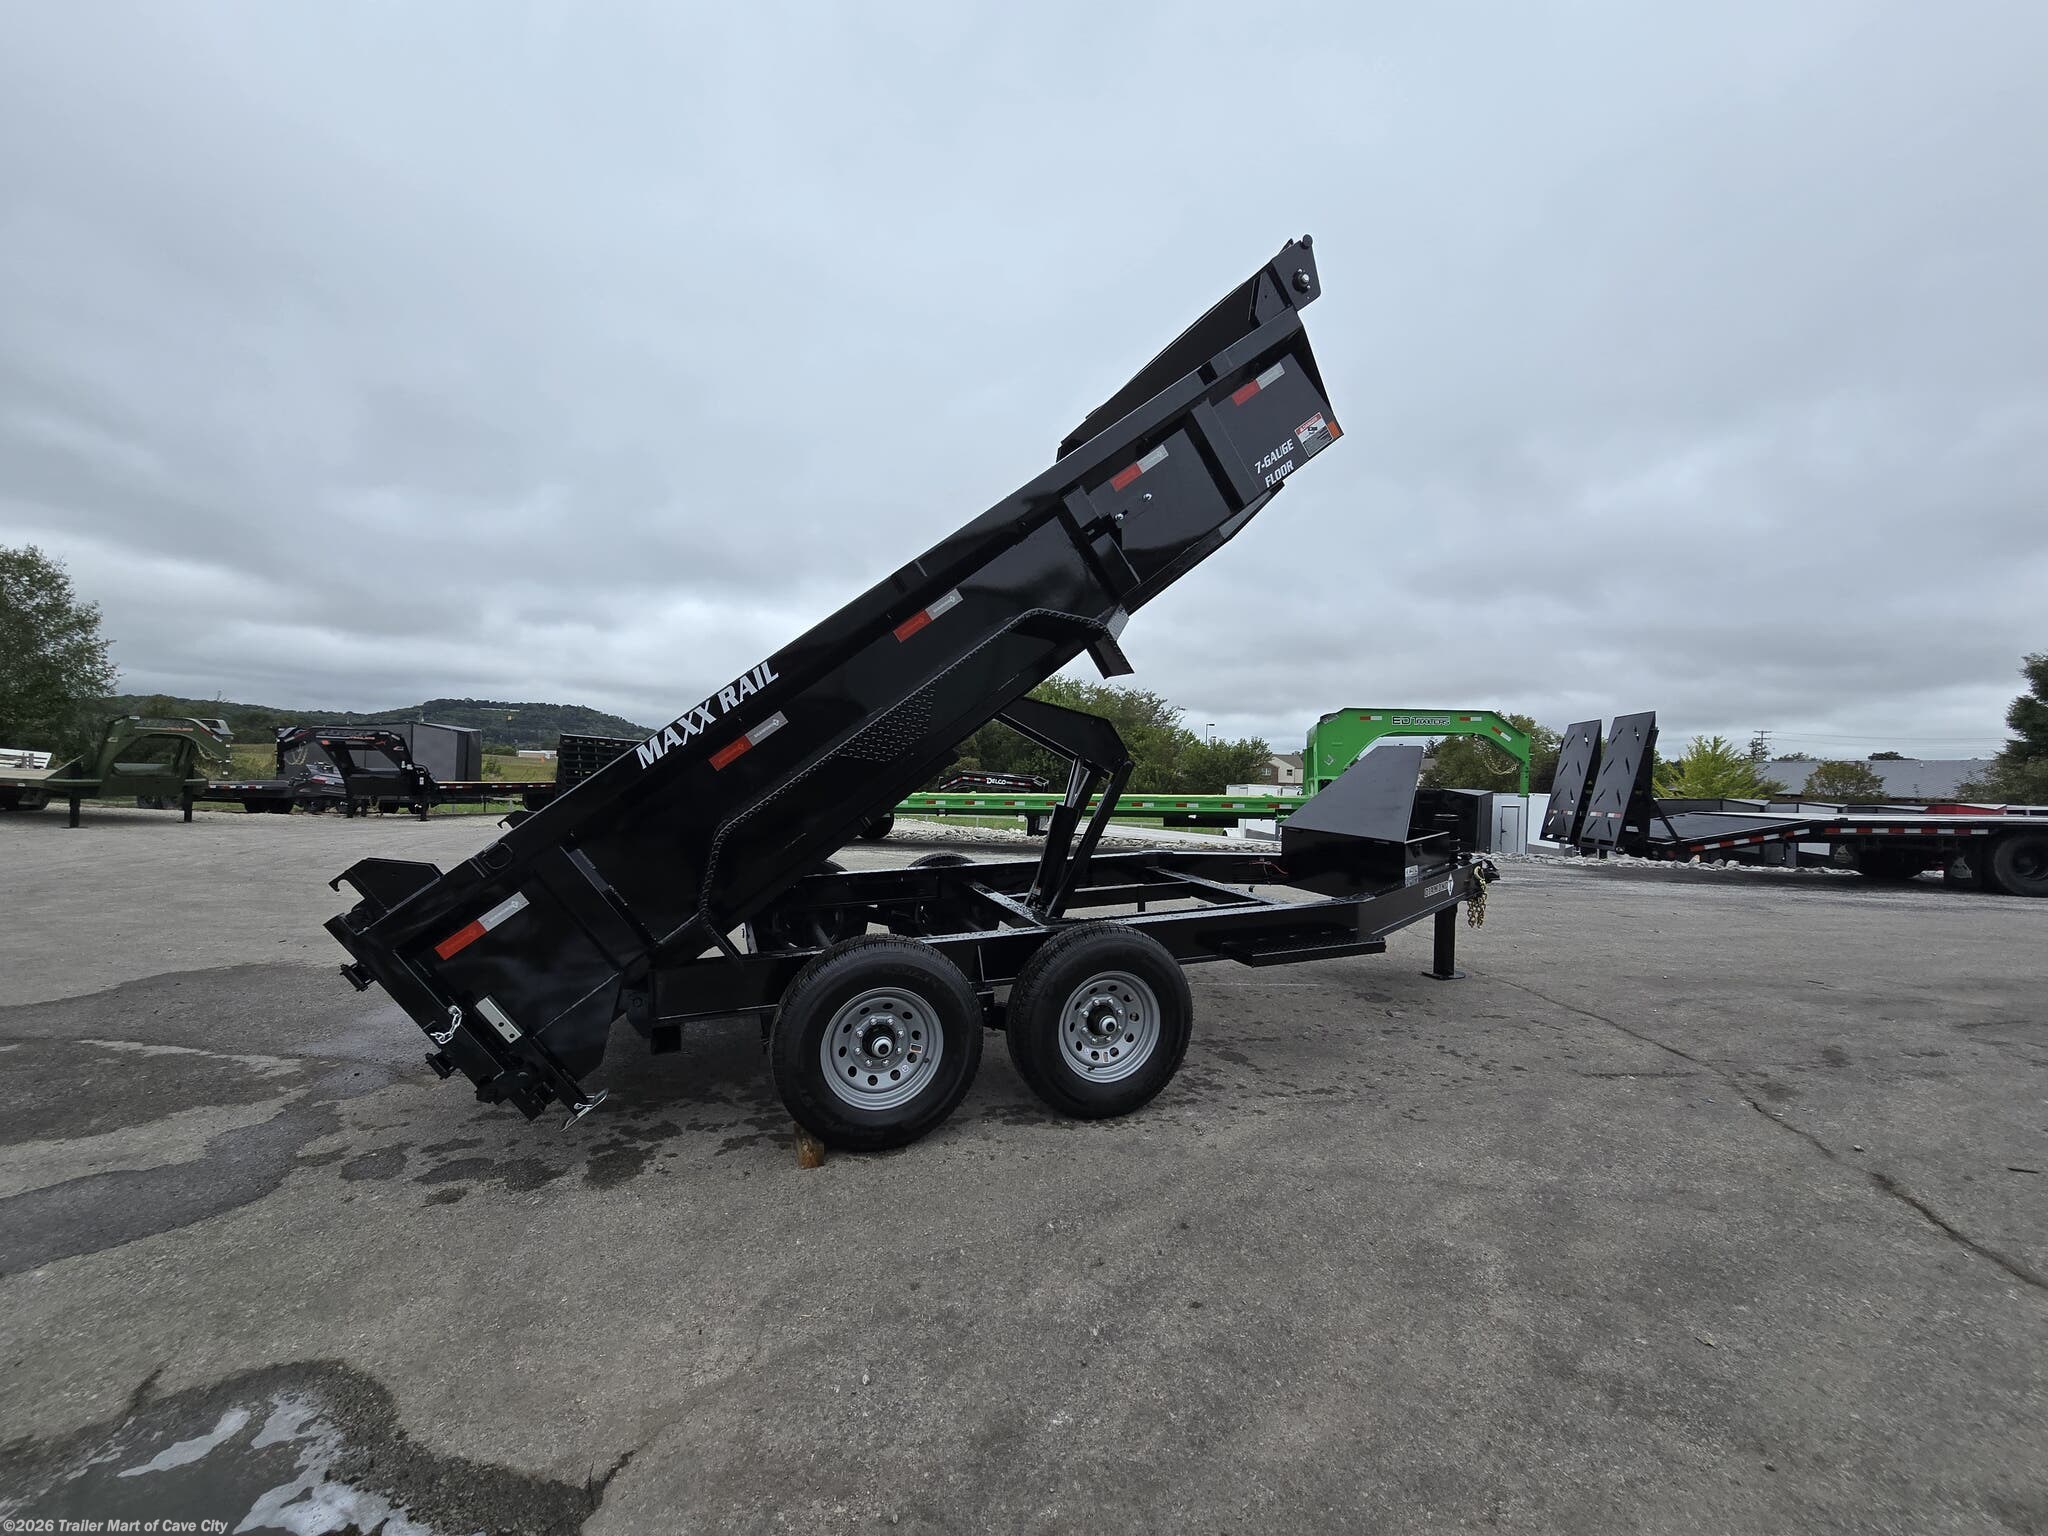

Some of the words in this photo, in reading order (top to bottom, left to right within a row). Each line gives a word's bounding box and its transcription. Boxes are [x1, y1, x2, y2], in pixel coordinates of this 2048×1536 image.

[1254, 438, 1295, 474] 7-GAUGE
[1264, 459, 1295, 488] FLOOR
[635, 700, 717, 770] MAXX
[717, 661, 779, 714] RAIL
[986, 777, 1007, 785] DELCO
